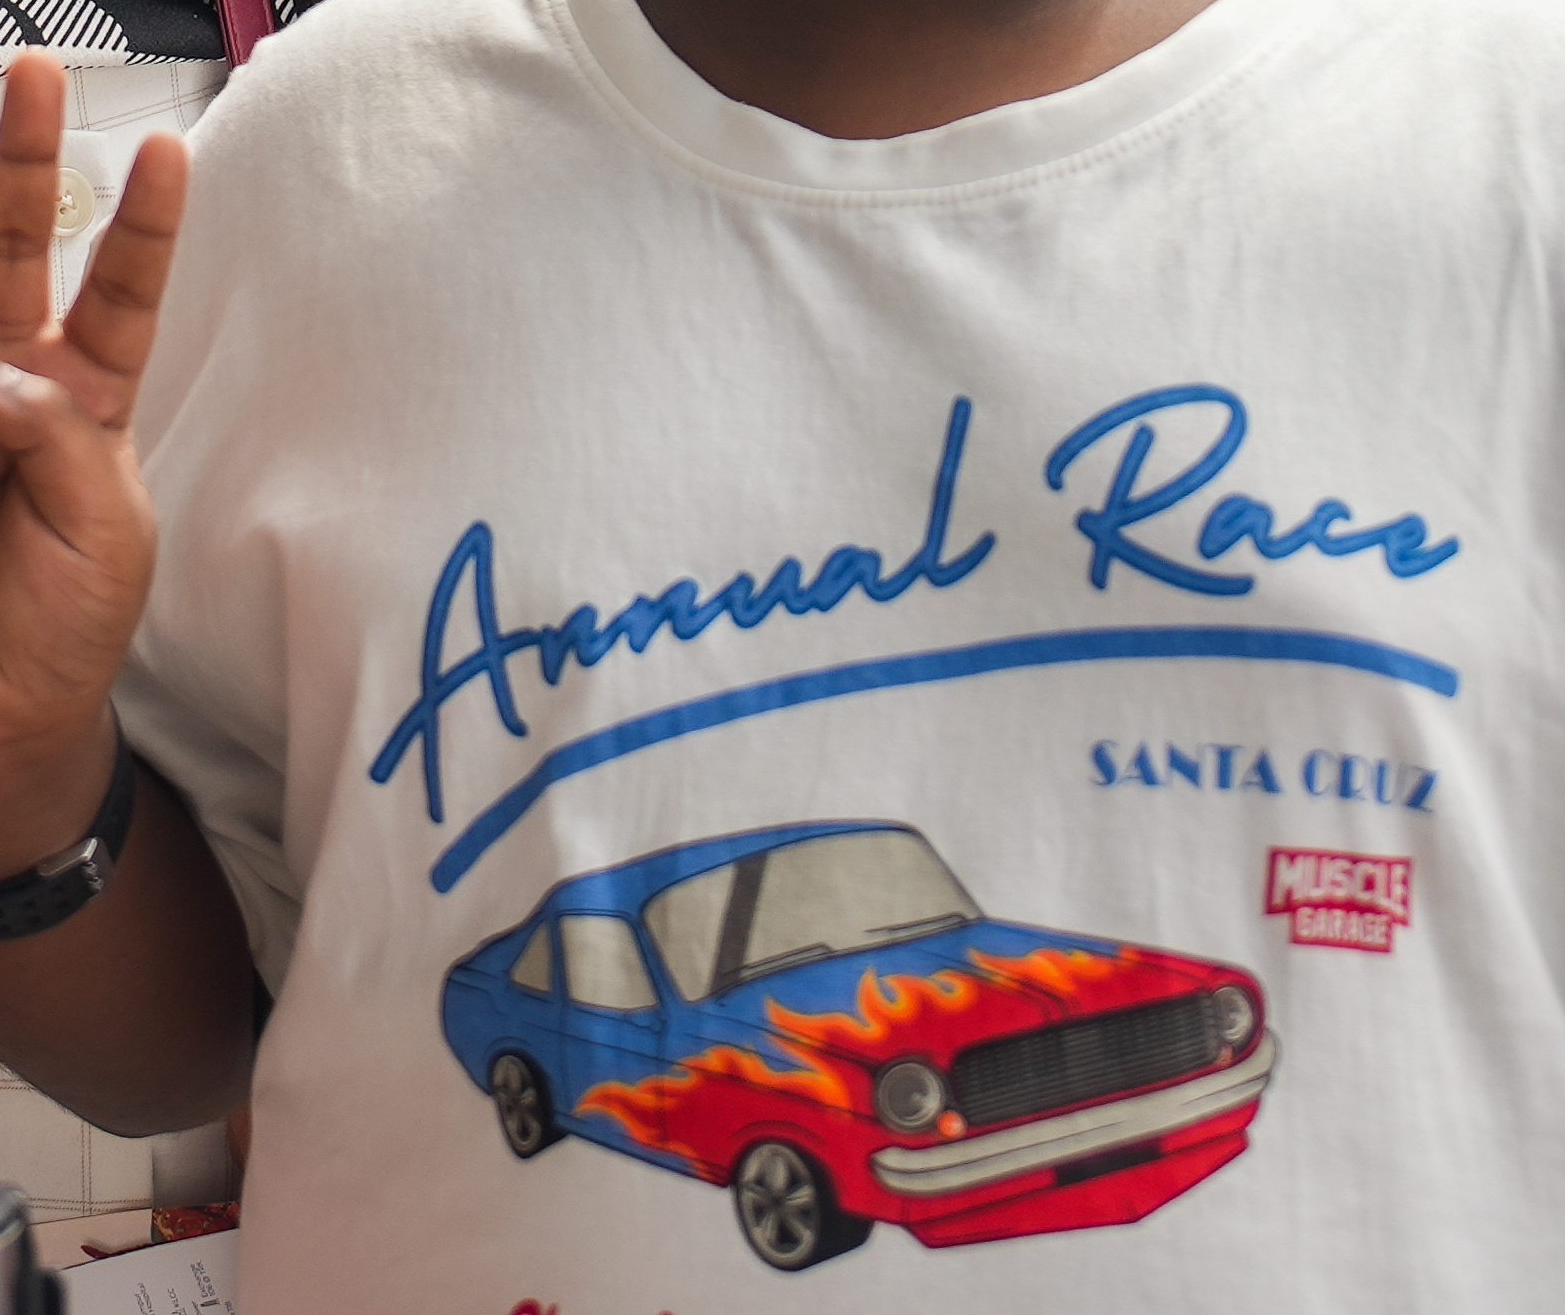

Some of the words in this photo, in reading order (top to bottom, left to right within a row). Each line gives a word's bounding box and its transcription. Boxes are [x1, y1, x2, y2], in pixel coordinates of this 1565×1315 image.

[368, 395, 996, 824] Annual
[1045, 382, 1459, 598] Race
[1088, 739, 1282, 795] SANTA
[1302, 747, 1440, 813] CRUZ
[1270, 852, 1410, 920] MUSCLE
[1294, 905, 1390, 945] GARAGE
